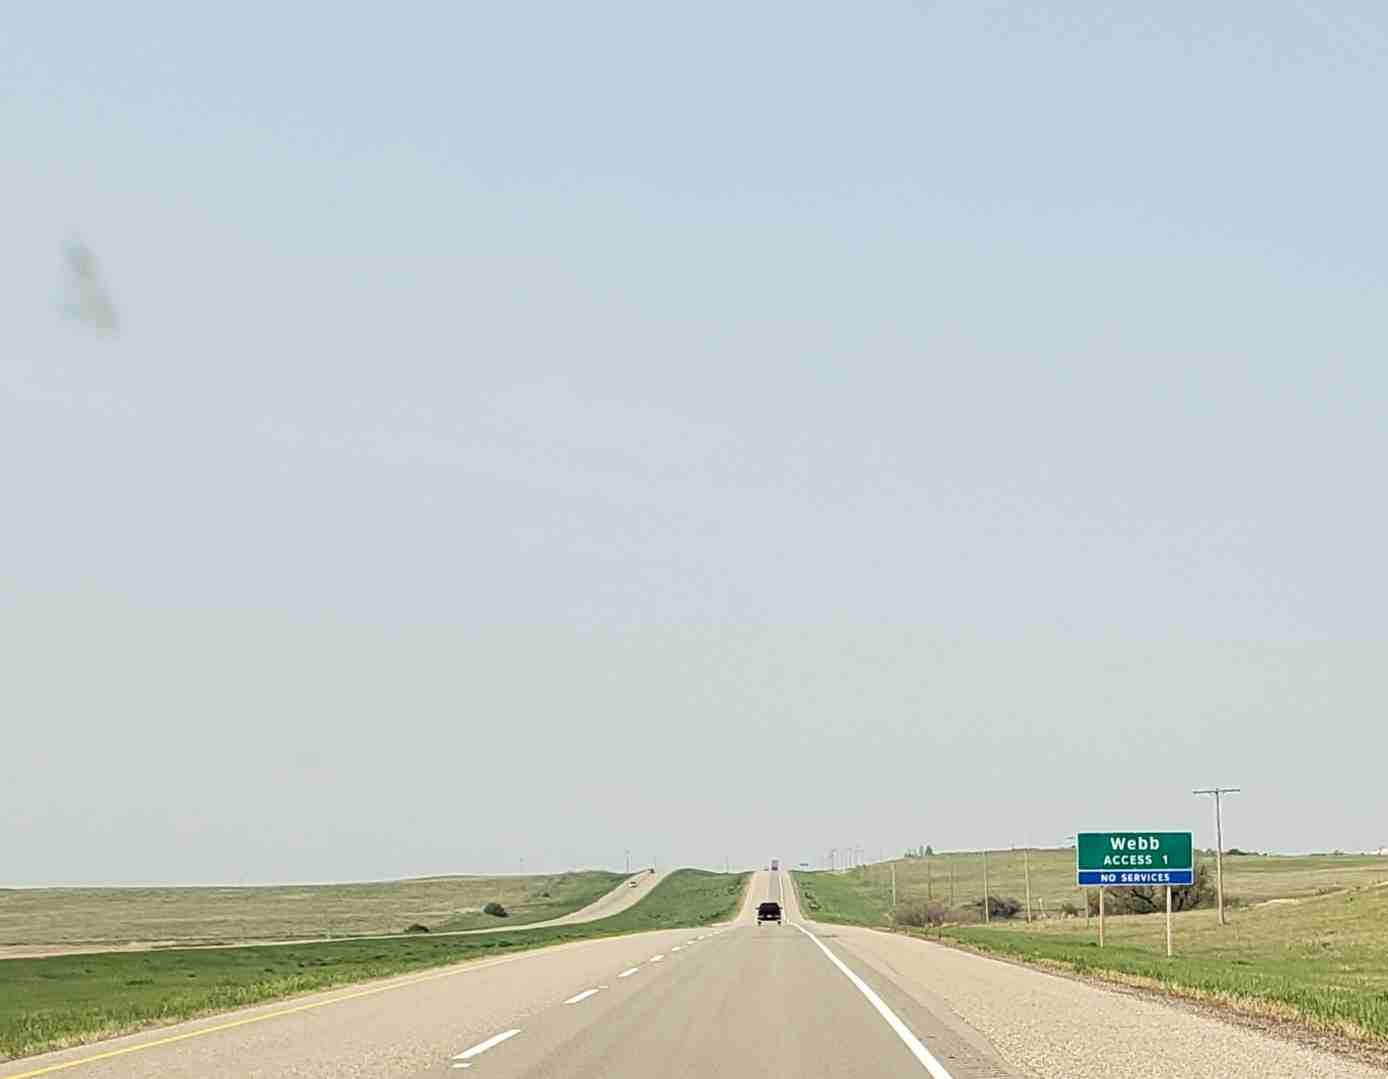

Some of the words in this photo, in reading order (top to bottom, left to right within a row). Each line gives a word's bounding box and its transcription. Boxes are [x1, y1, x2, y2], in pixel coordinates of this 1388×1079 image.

[1110, 836, 1160, 850] Webb
[1103, 855, 1153, 865] ACCESS
[1162, 855, 1168, 865] 1
[1100, 873, 1117, 882] NO
[1121, 873, 1170, 882] SERVICES
